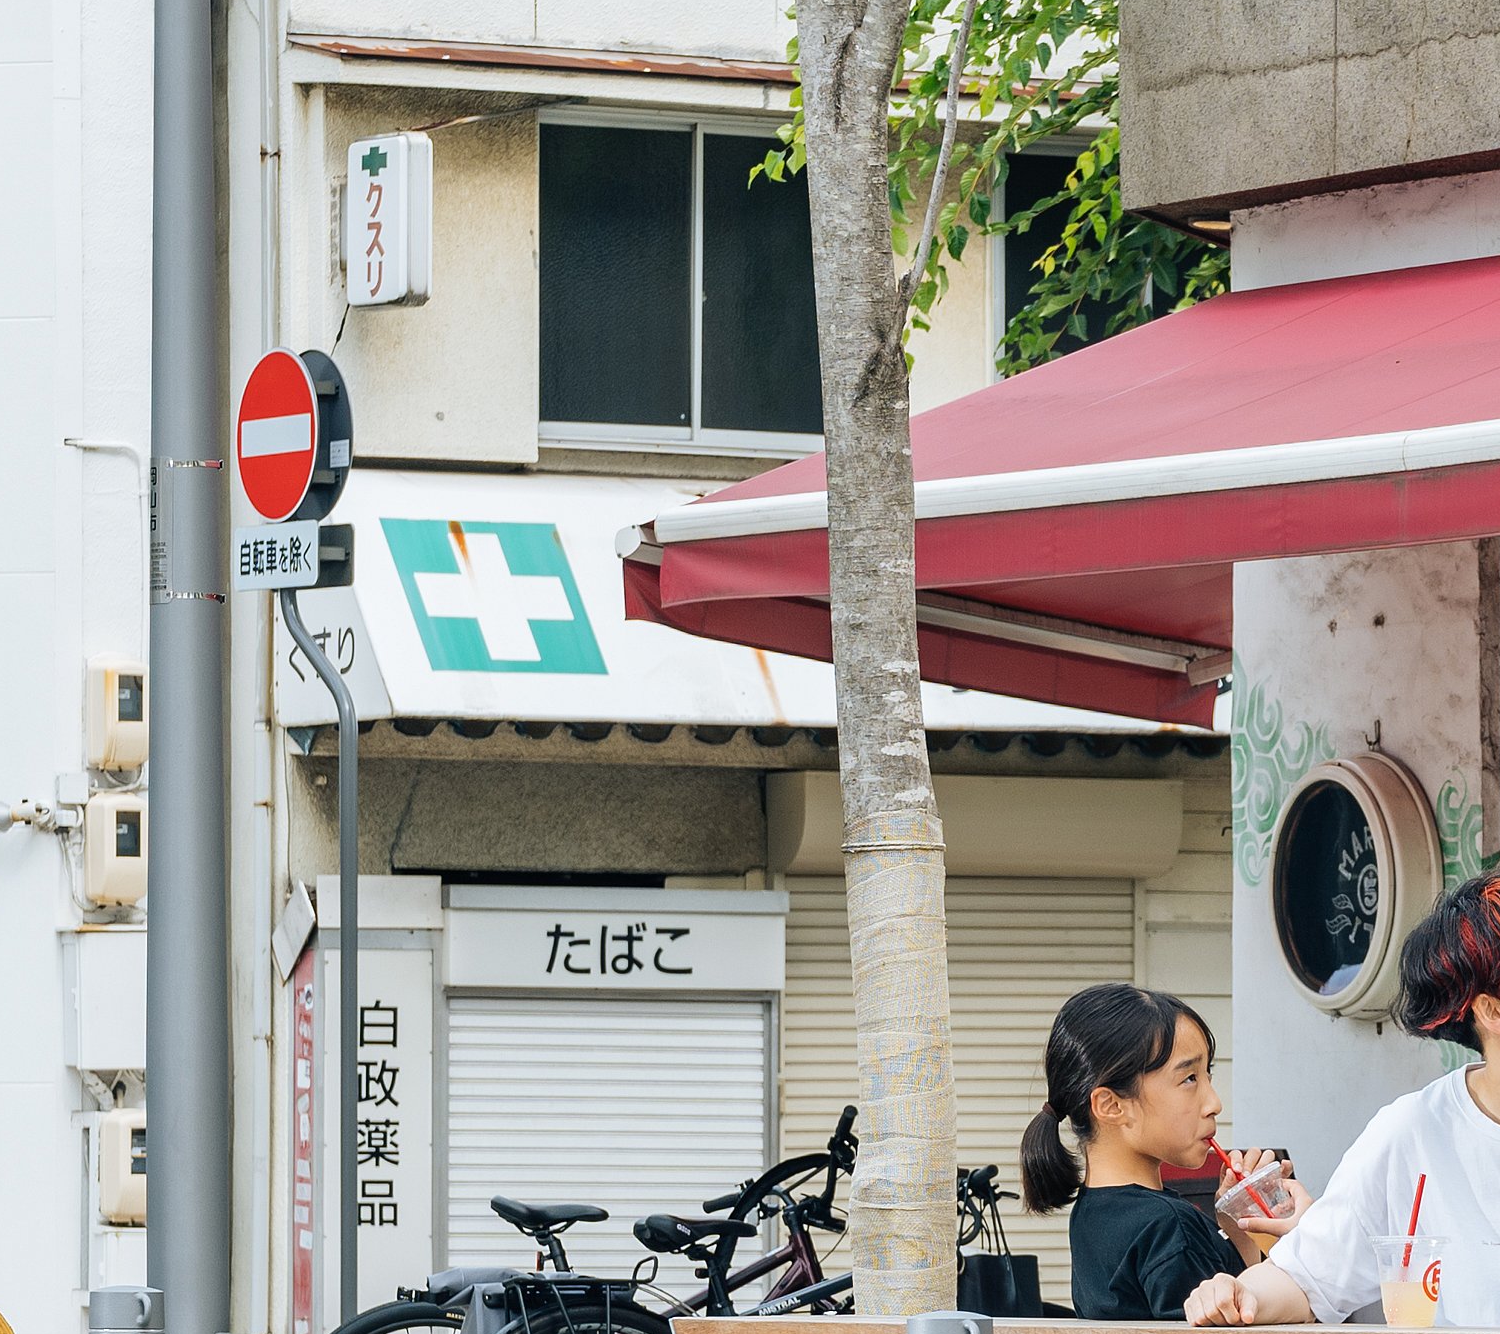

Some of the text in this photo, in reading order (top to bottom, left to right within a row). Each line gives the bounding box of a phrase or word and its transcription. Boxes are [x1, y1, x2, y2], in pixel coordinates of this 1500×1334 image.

[366, 182, 385, 298] クスリ
[241, 537, 312, 577] 自転車を除く
[545, 922, 693, 975] たばこ
[357, 1000, 399, 1227] 白政薬品
[758, 1296, 802, 1317] MISTRAL
